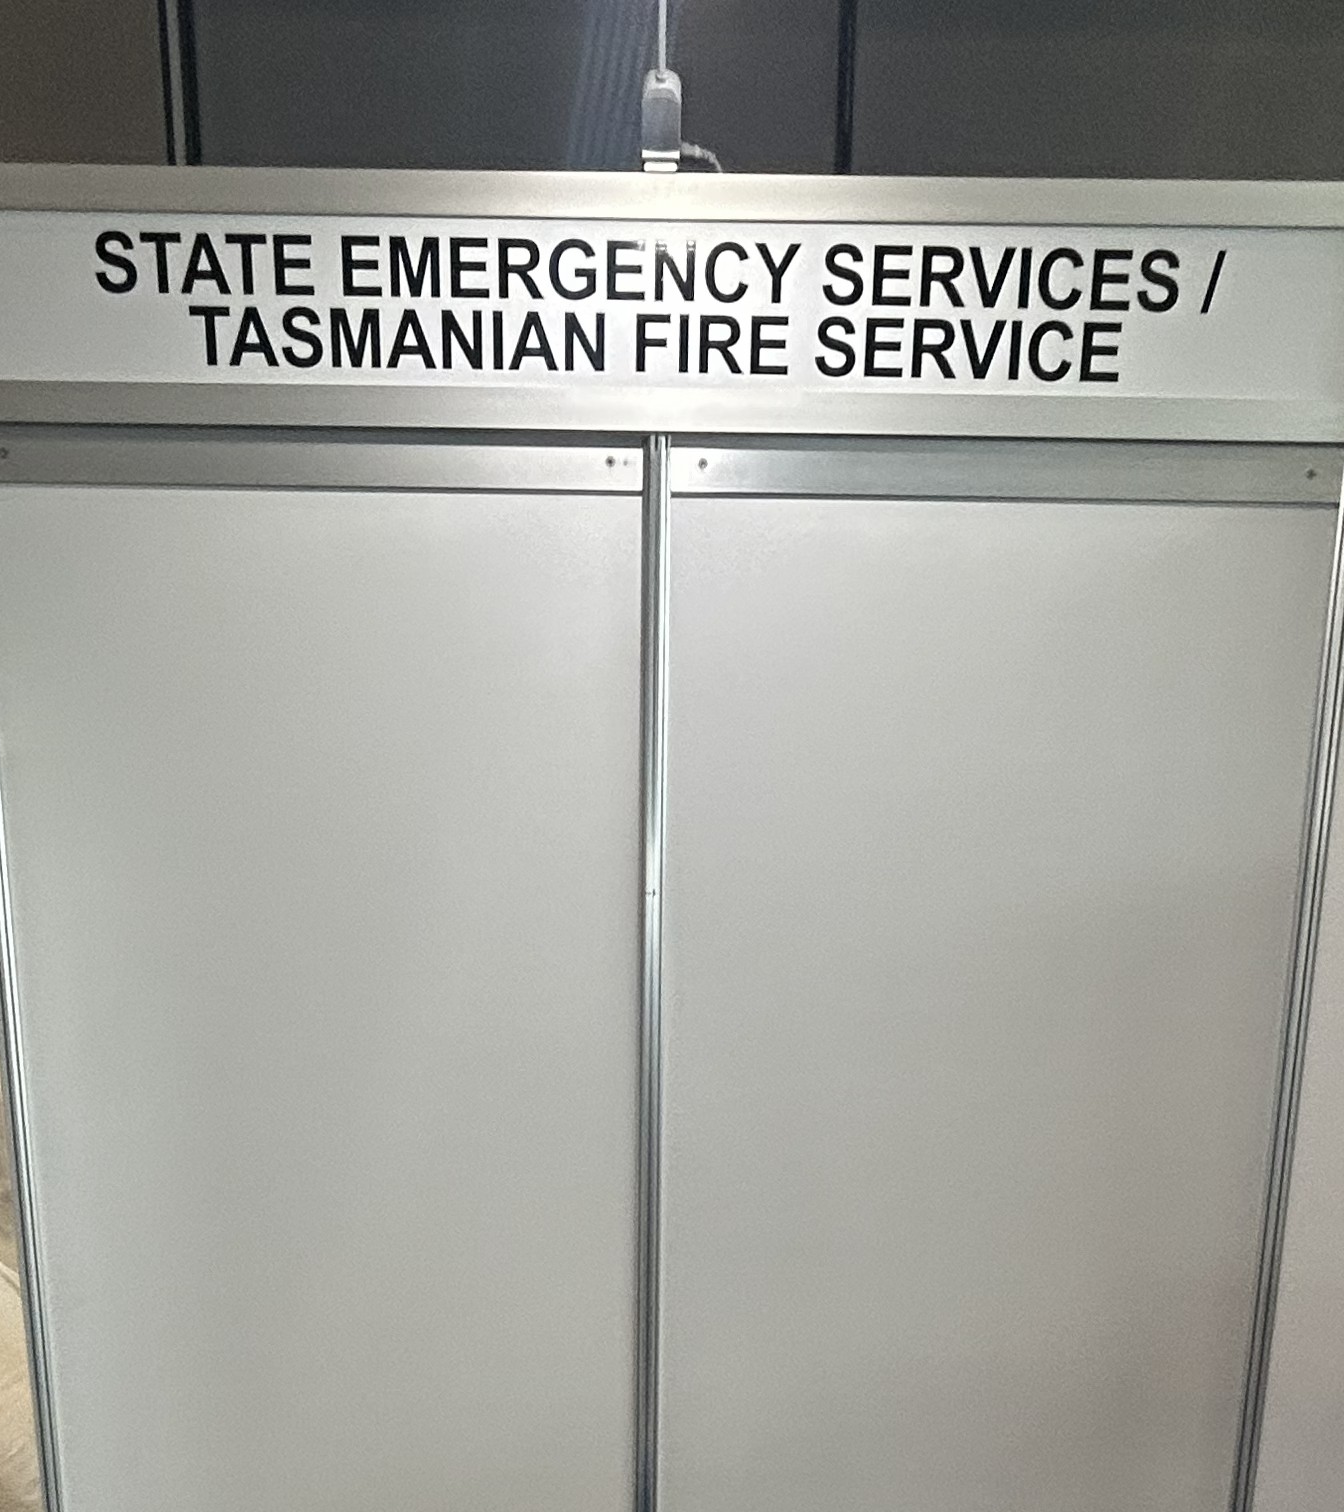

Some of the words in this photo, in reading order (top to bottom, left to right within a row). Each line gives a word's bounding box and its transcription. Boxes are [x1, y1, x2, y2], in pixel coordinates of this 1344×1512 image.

[94, 230, 314, 297] STATE
[339, 235, 800, 306] EMERGENCY
[821, 243, 1182, 312] SERVICES
[1200, 252, 1225, 315] /
[188, 303, 608, 373] TASMANIAN
[635, 316, 789, 376] FIRE
[814, 316, 1121, 383] SERVICE
